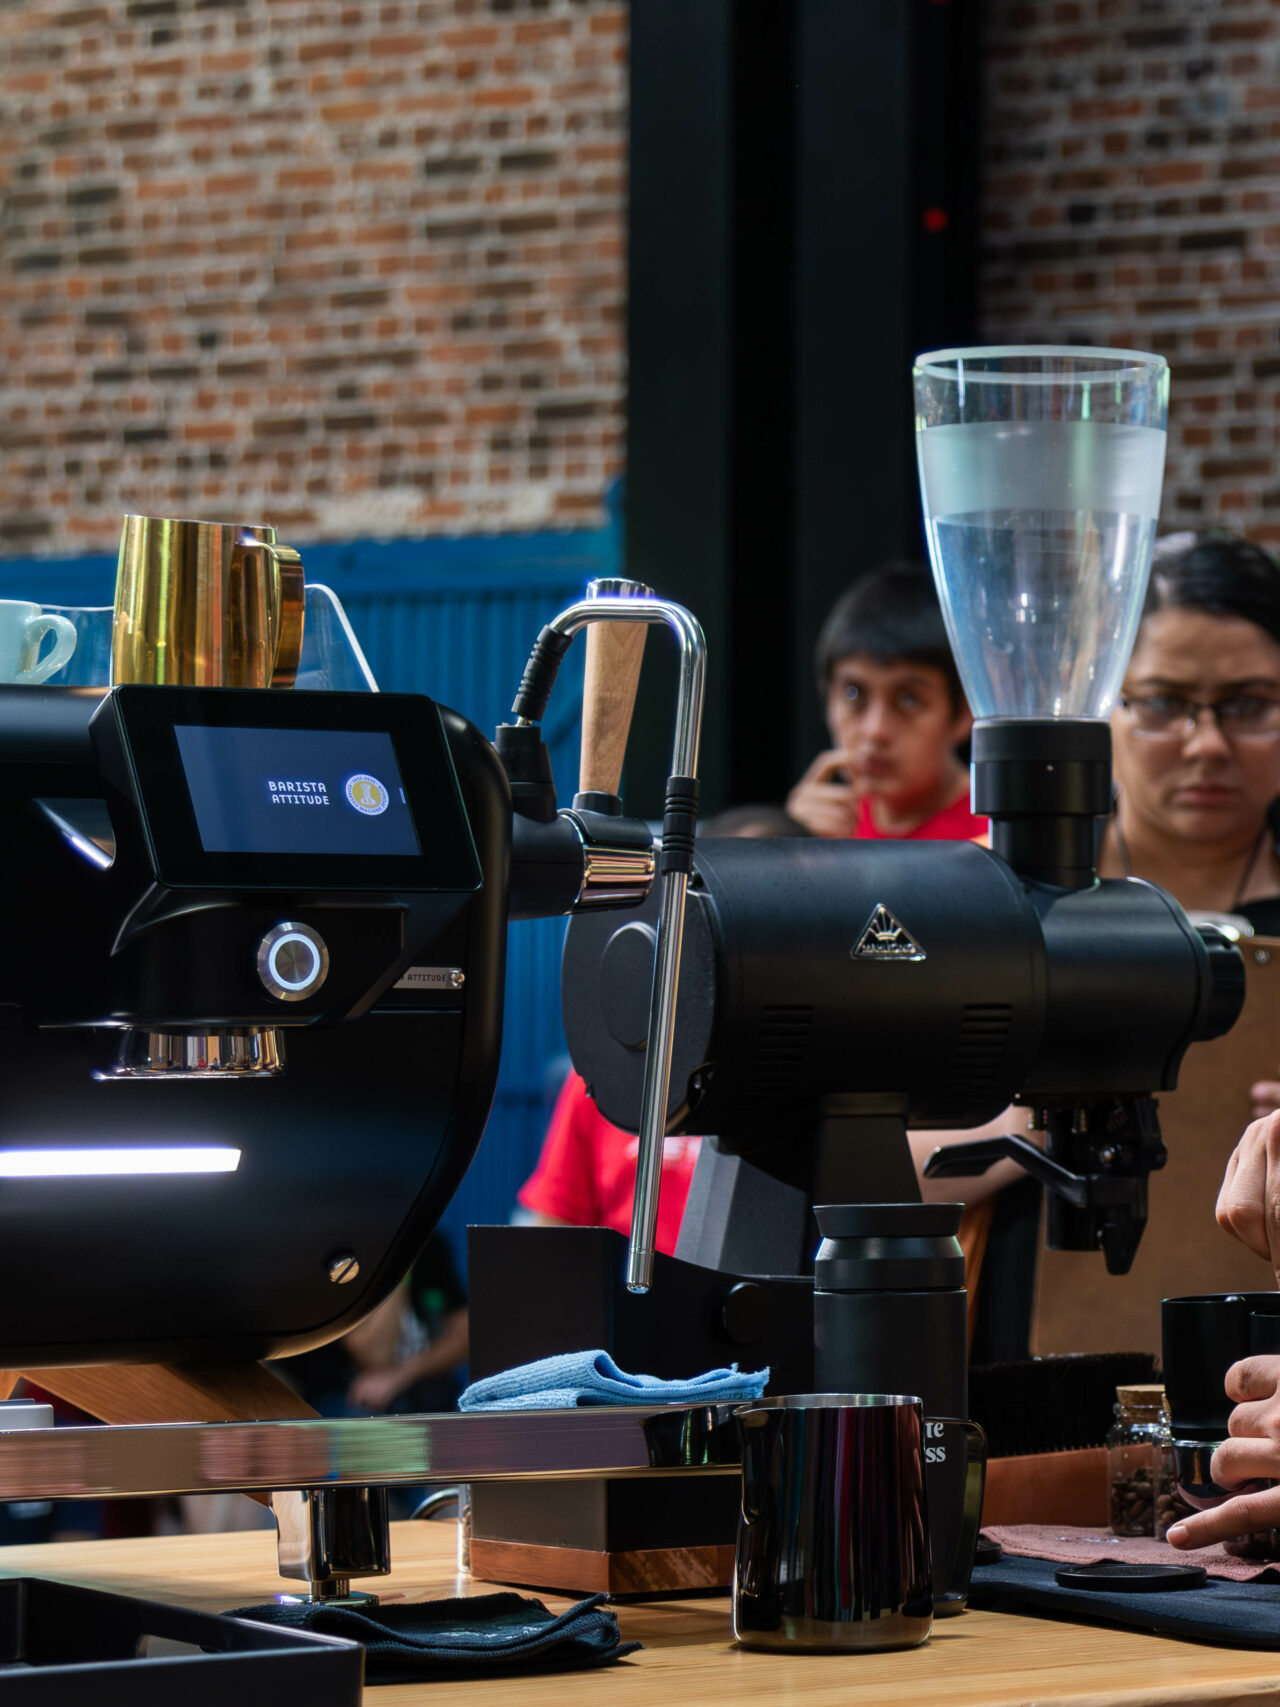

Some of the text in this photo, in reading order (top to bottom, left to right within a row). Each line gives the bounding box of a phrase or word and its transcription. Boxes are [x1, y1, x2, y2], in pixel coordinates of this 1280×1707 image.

[268, 781, 327, 793] BARISTA
[272, 794, 330, 805] ATTITUDE
[407, 974, 446, 982] ATTITUDE
[925, 1422, 944, 1438] te
[925, 1447, 946, 1463] ss
